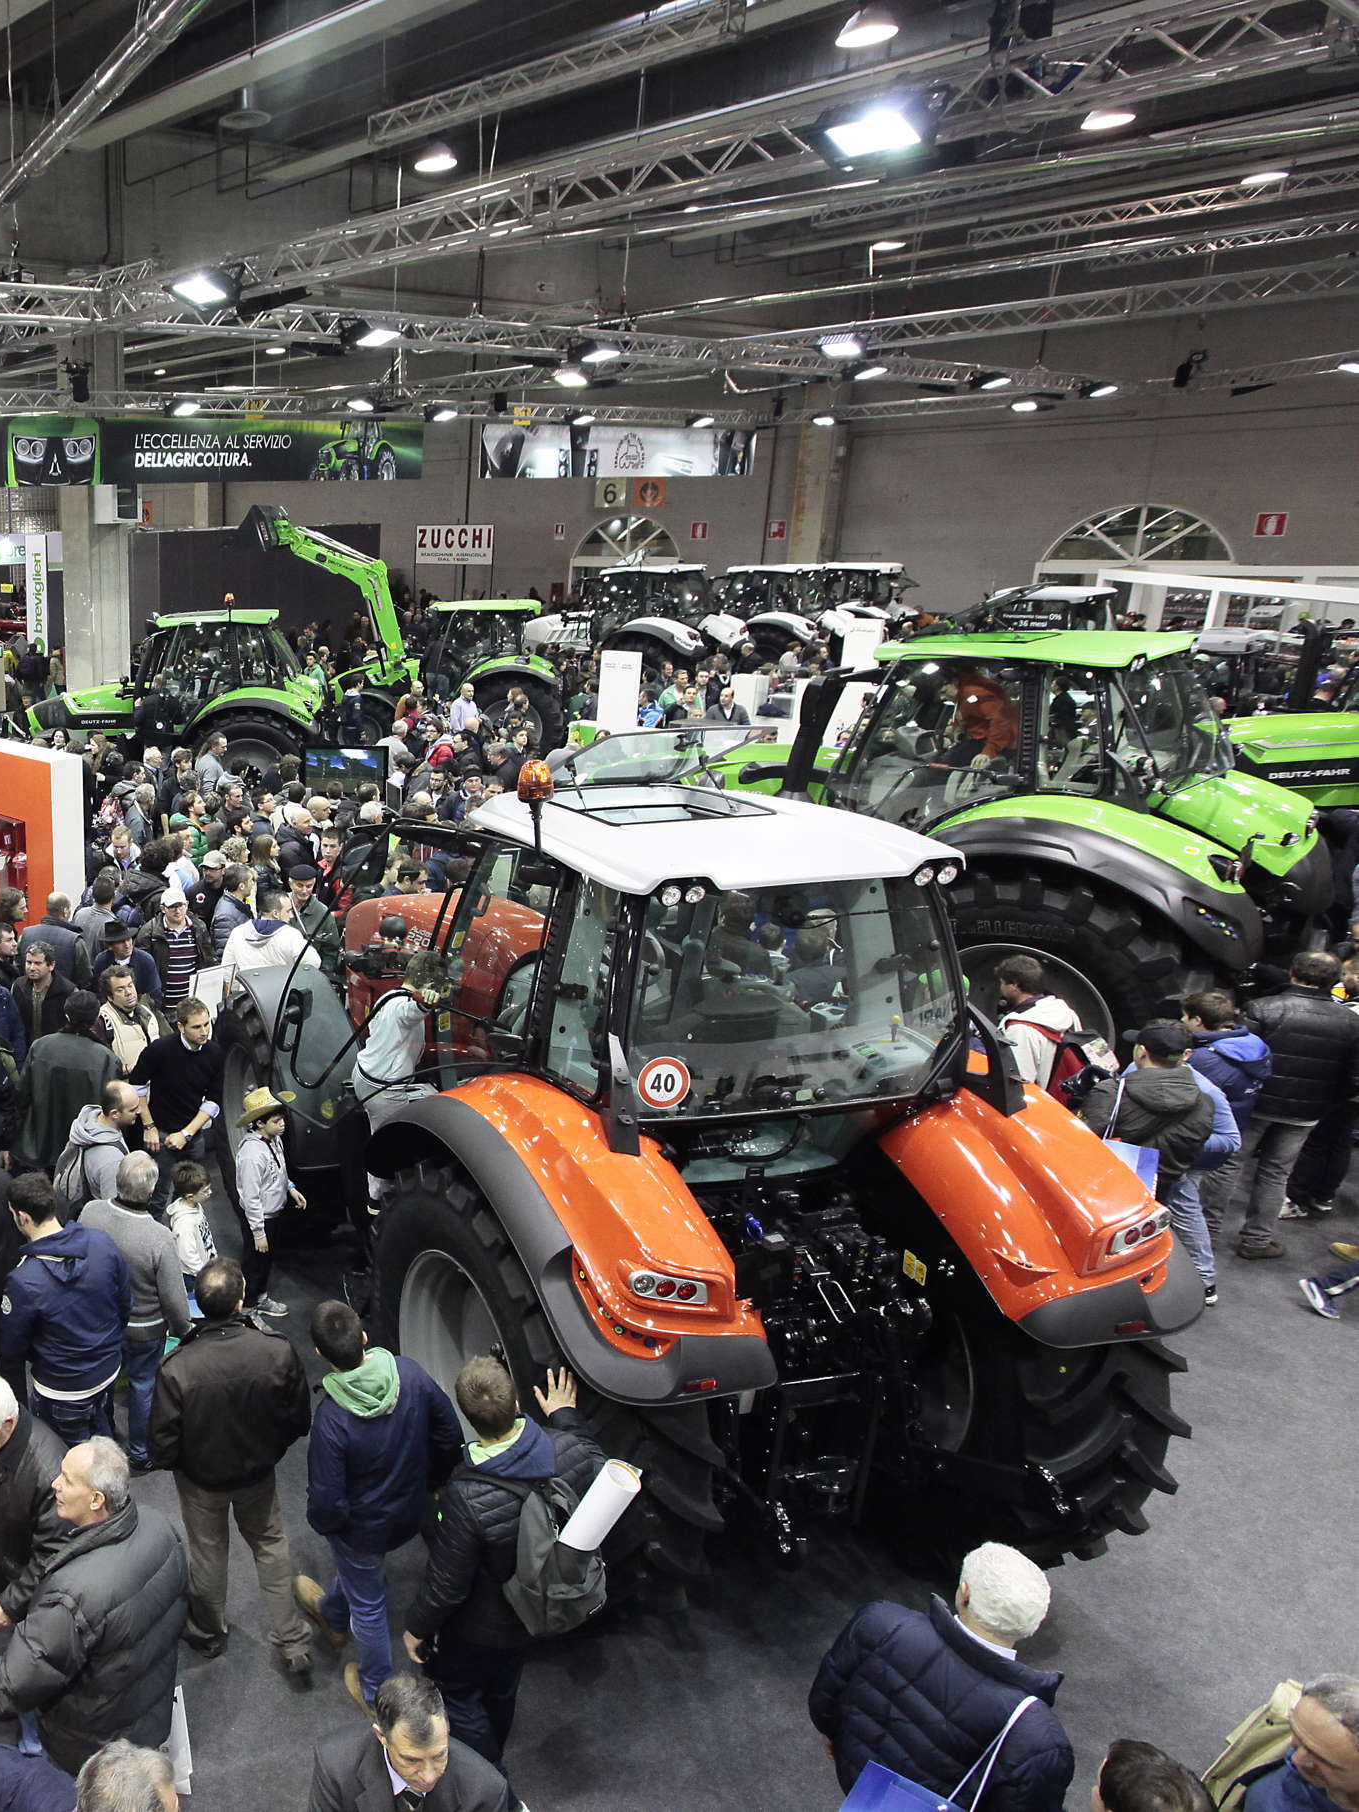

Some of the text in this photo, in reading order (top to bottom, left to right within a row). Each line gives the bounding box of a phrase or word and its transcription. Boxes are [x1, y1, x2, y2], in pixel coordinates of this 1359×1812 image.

[134, 433, 292, 449] L'ECCELLENZA AL SERVIZIO
[134, 452, 252, 468] DELL'AGRICOLTURA.
[604, 483, 617, 504] 6
[418, 528, 492, 549] ZUCCHI
[32, 552, 45, 634] breviglieri
[1268, 768, 1351, 780] DEUTZ-FAHR
[650, 1073, 676, 1093] 40
